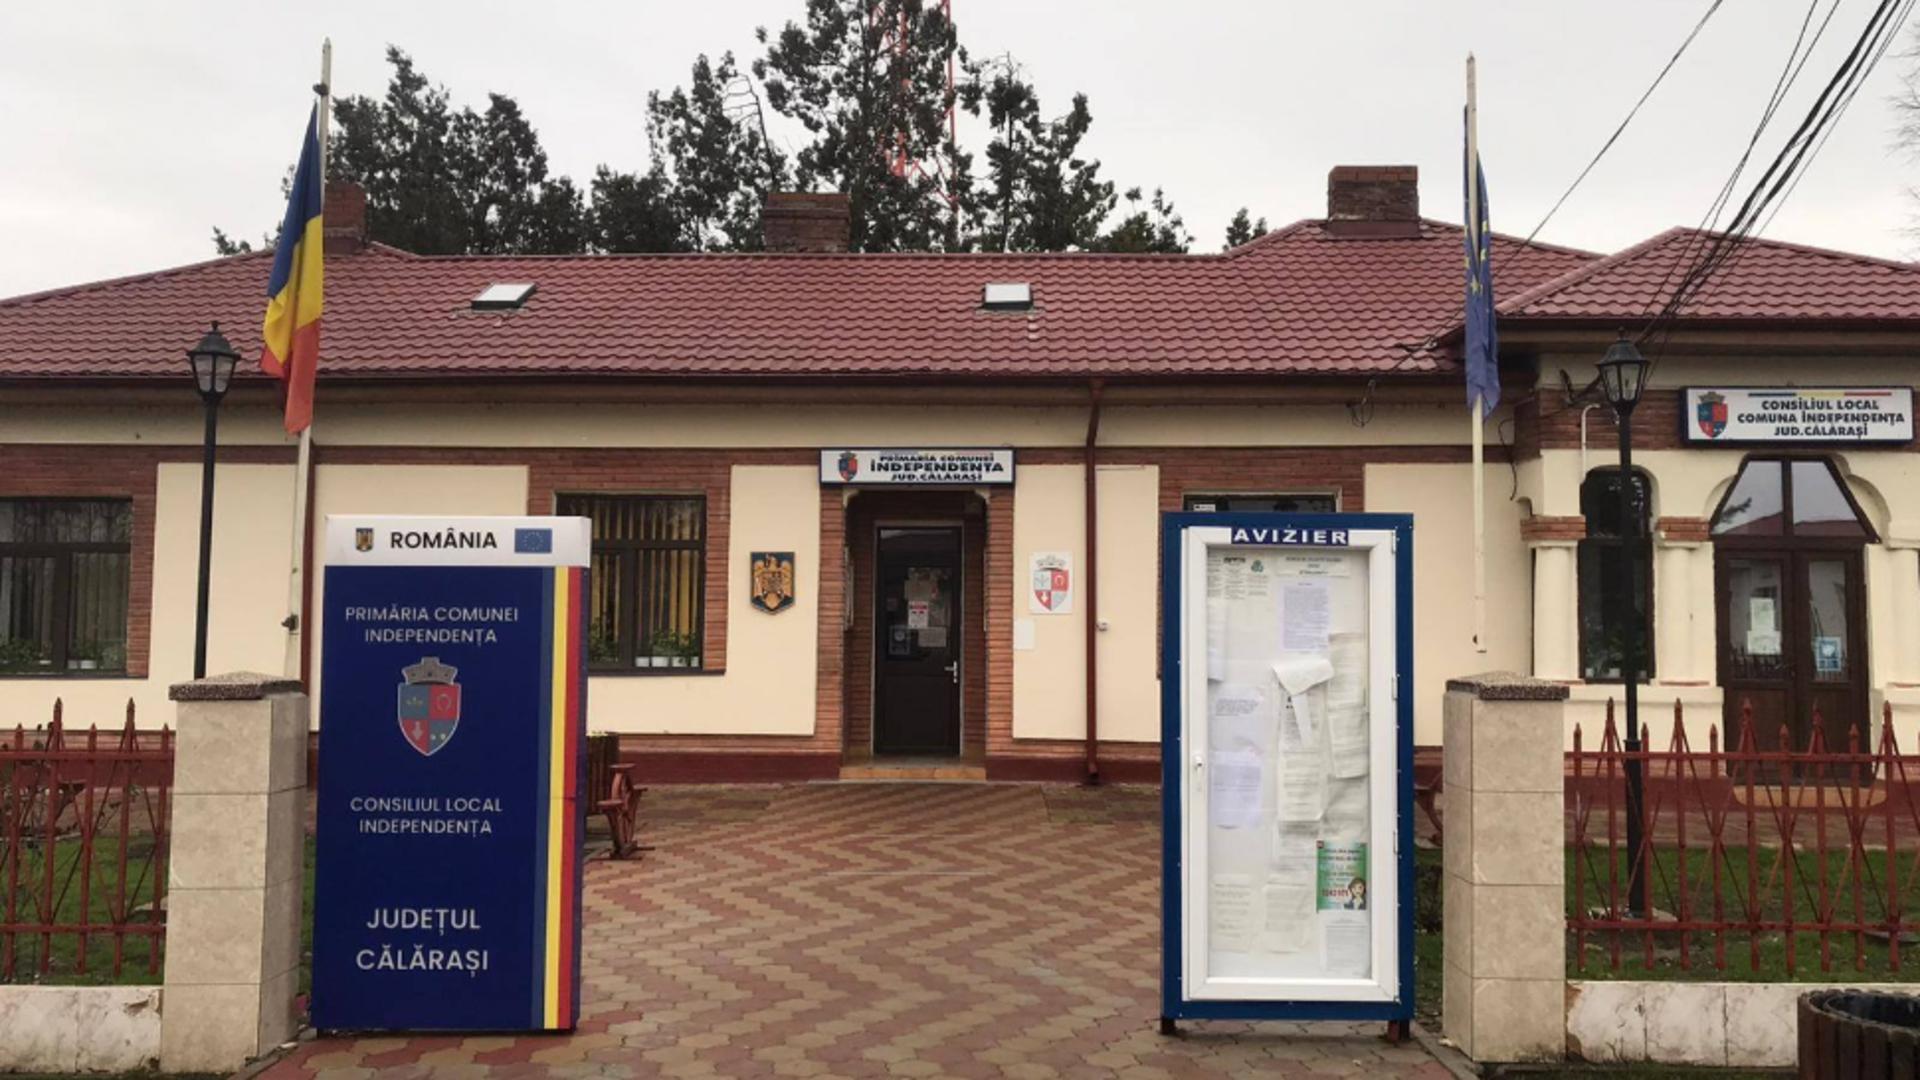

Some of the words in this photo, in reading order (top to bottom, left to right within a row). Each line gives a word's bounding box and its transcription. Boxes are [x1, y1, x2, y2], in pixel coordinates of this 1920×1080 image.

[1837, 399, 1880, 411] LOCAL
[1737, 412, 1797, 424] COMUNA
[390, 528, 498, 549] ROMÂNIA
[1233, 529, 1348, 545] AVIZIER
[345, 605, 429, 622] PRIMĂRIA
[434, 606, 519, 622] COMUNEI
[365, 628, 498, 646] INDEPENDENȚA
[350, 796, 440, 812] CONSILIUL
[445, 797, 503, 812] LOCAL
[359, 819, 493, 837] INDEPENDENȚA
[366, 908, 481, 936] JUDEȚUL
[355, 944, 488, 978] CĂLĂRAȘI
